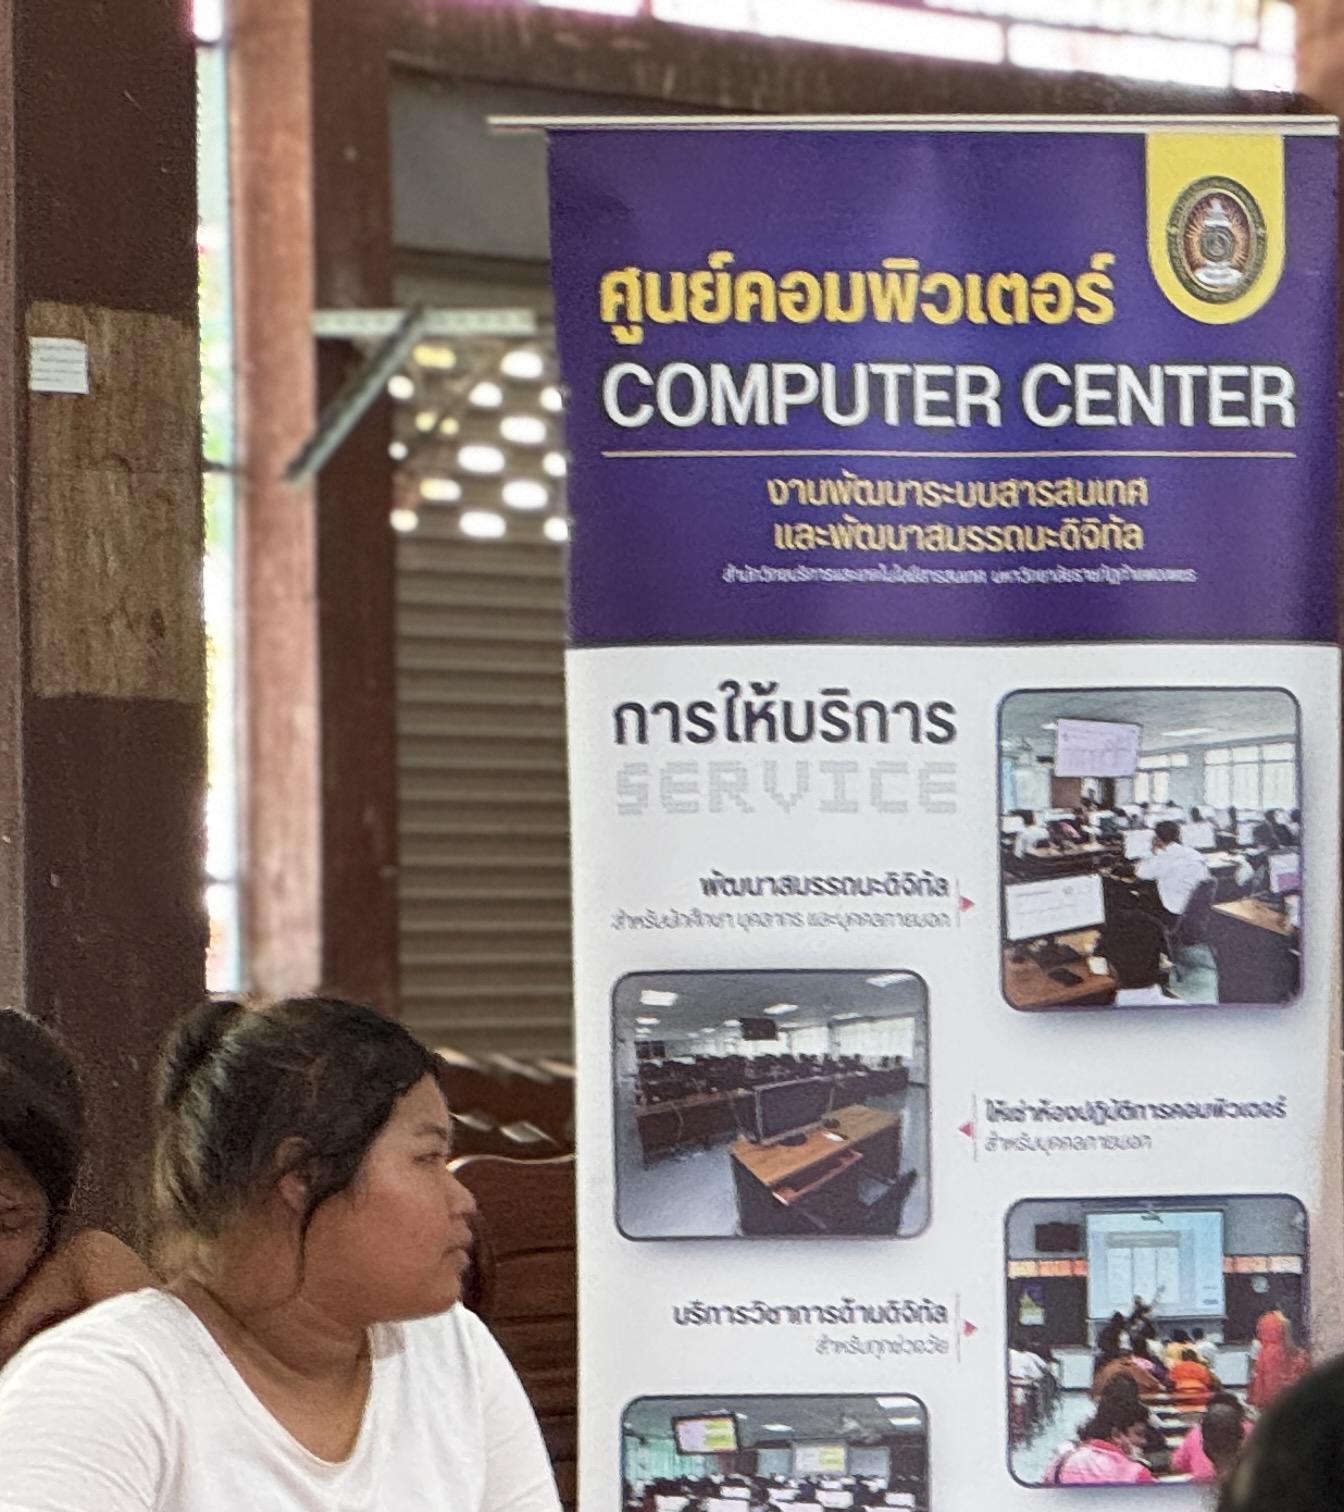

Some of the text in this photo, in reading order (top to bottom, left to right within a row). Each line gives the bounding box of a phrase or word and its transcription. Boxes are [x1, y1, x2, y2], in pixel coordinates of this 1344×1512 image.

[601, 251, 1116, 345] ศูนย์คอมพิวเตอร์
[603, 362, 1297, 428] COMPUTER CENTER
[766, 469, 1149, 508] งานพัฒนาระบบสารสนเทศ
[613, 681, 958, 746] การให้บริการ
[616, 760, 958, 816] SERVICE
